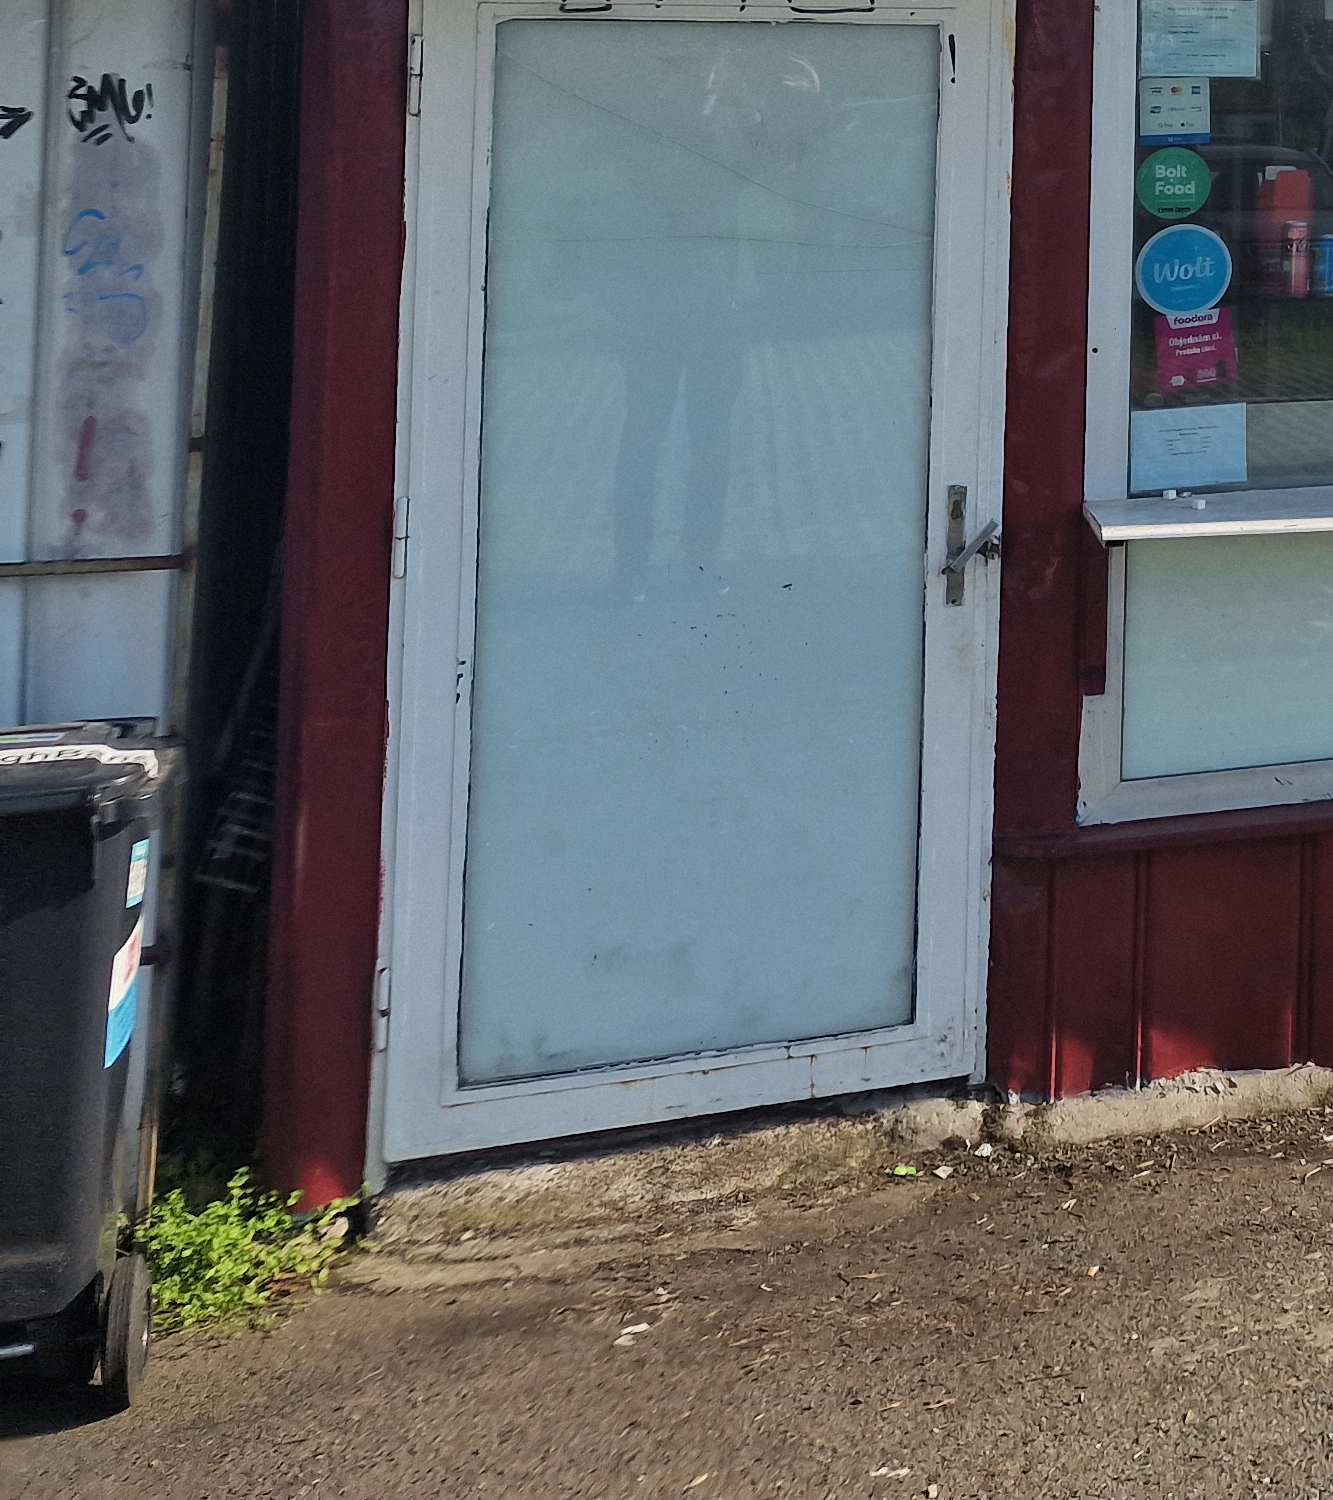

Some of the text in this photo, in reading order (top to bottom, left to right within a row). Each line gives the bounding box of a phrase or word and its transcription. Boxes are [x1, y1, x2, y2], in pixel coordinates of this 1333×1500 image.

[1156, 164, 1187, 178] Bolt
[1155, 181, 1195, 195] Food
[1154, 257, 1215, 283] Wolt
[1174, 314, 1213, 325] foodora
